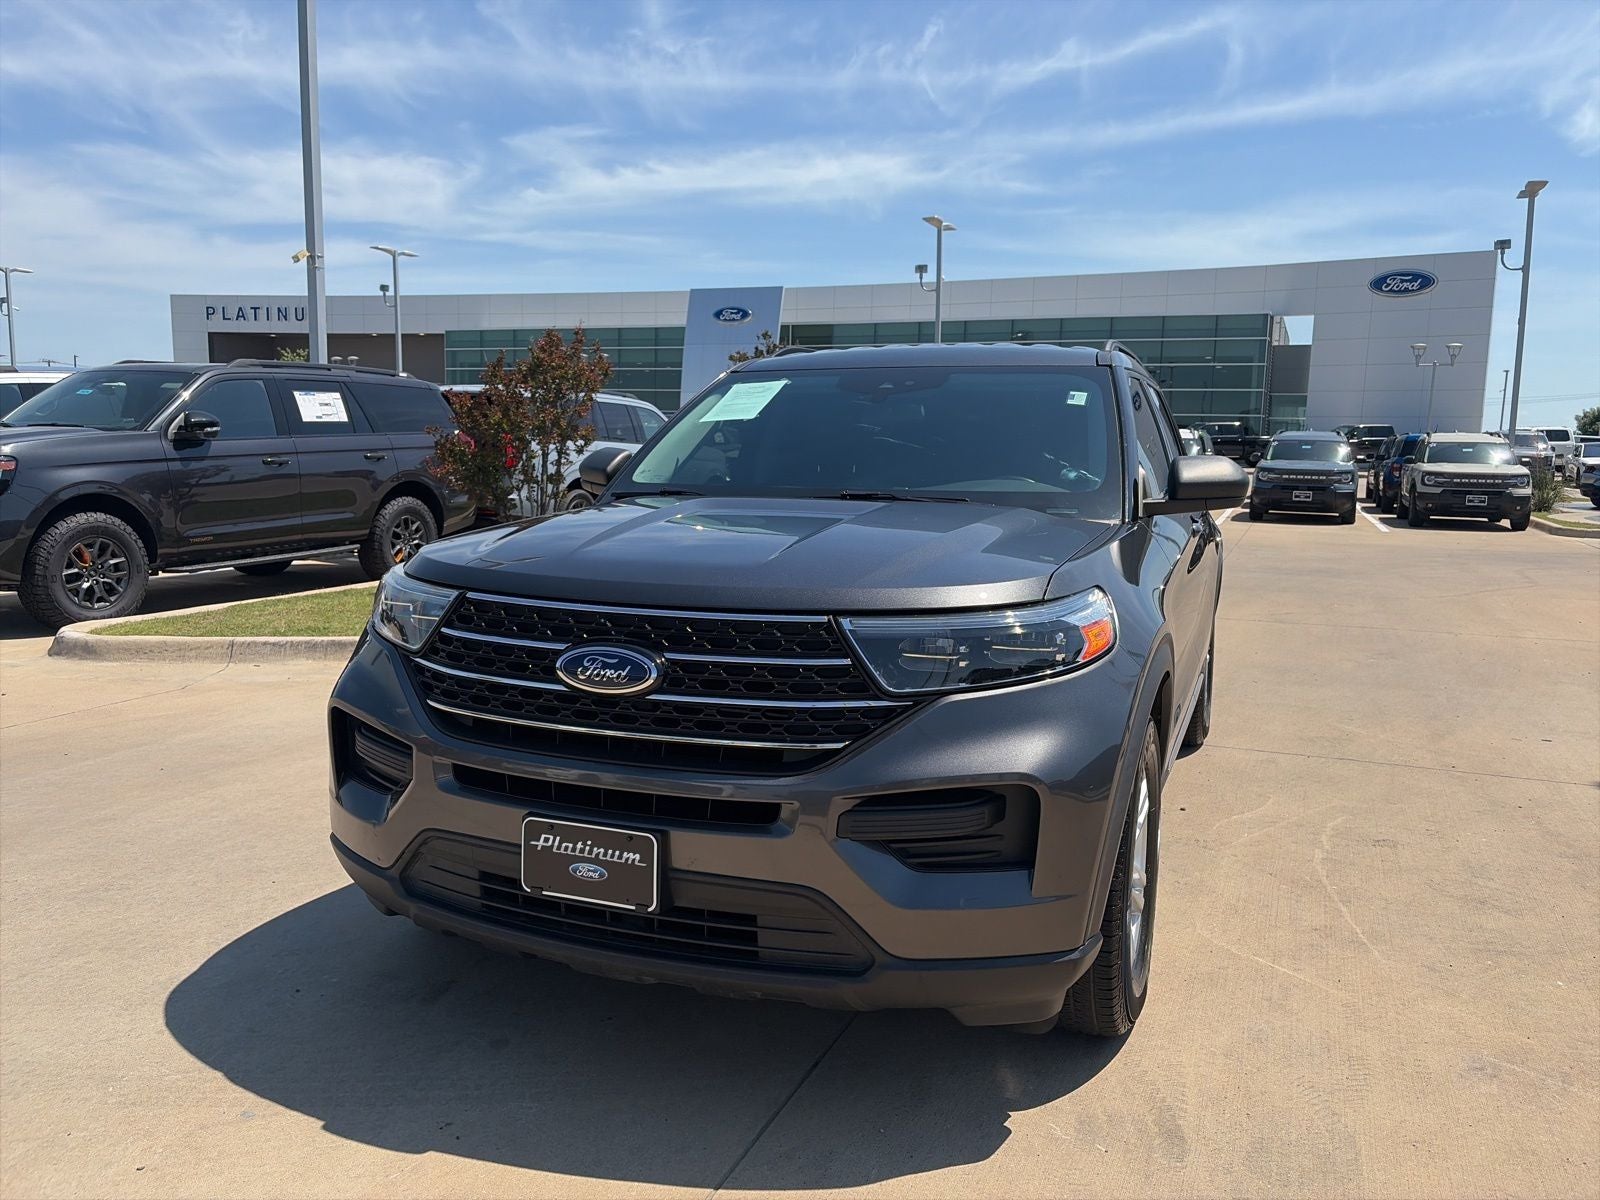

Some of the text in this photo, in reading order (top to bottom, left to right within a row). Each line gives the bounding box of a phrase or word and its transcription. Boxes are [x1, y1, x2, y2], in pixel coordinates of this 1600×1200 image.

[1382, 275, 1422, 291] Ford
[206, 306, 305, 321] PLATINU
[720, 309, 743, 320] Ford
[577, 655, 631, 682] Ford
[530, 833, 647, 867] Platinum
[576, 866, 600, 879] Ford
